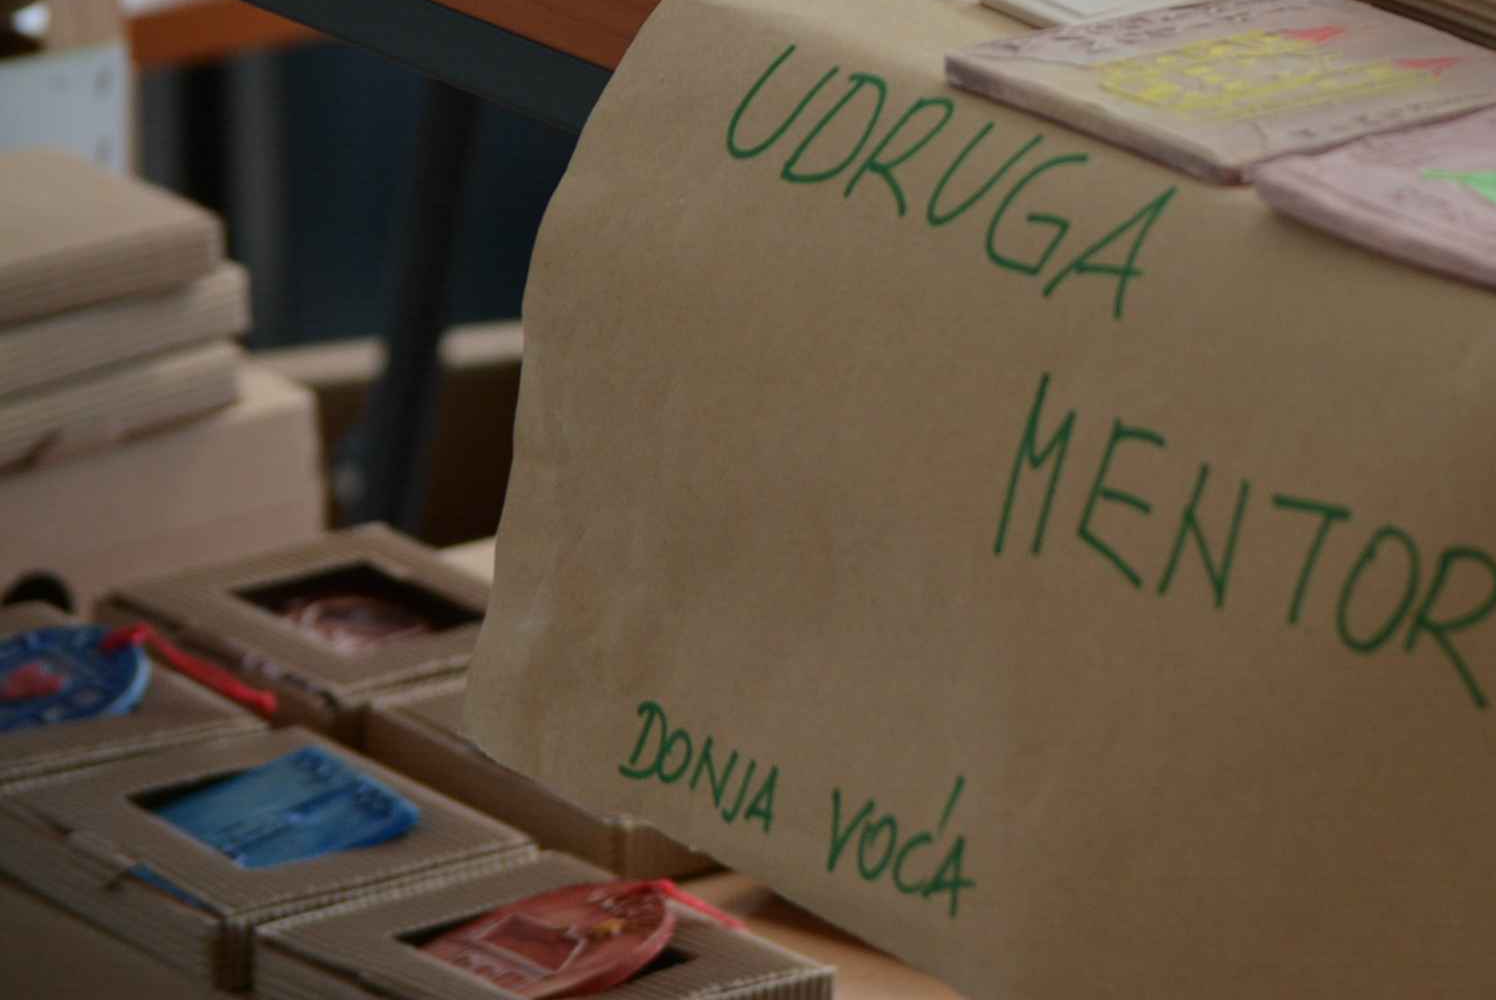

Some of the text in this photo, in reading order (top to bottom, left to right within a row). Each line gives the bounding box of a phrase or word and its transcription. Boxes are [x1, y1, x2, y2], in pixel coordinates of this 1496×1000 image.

[725, 45, 1178, 319] UDRUGA
[618, 701, 976, 917] DONJA VOĆA
